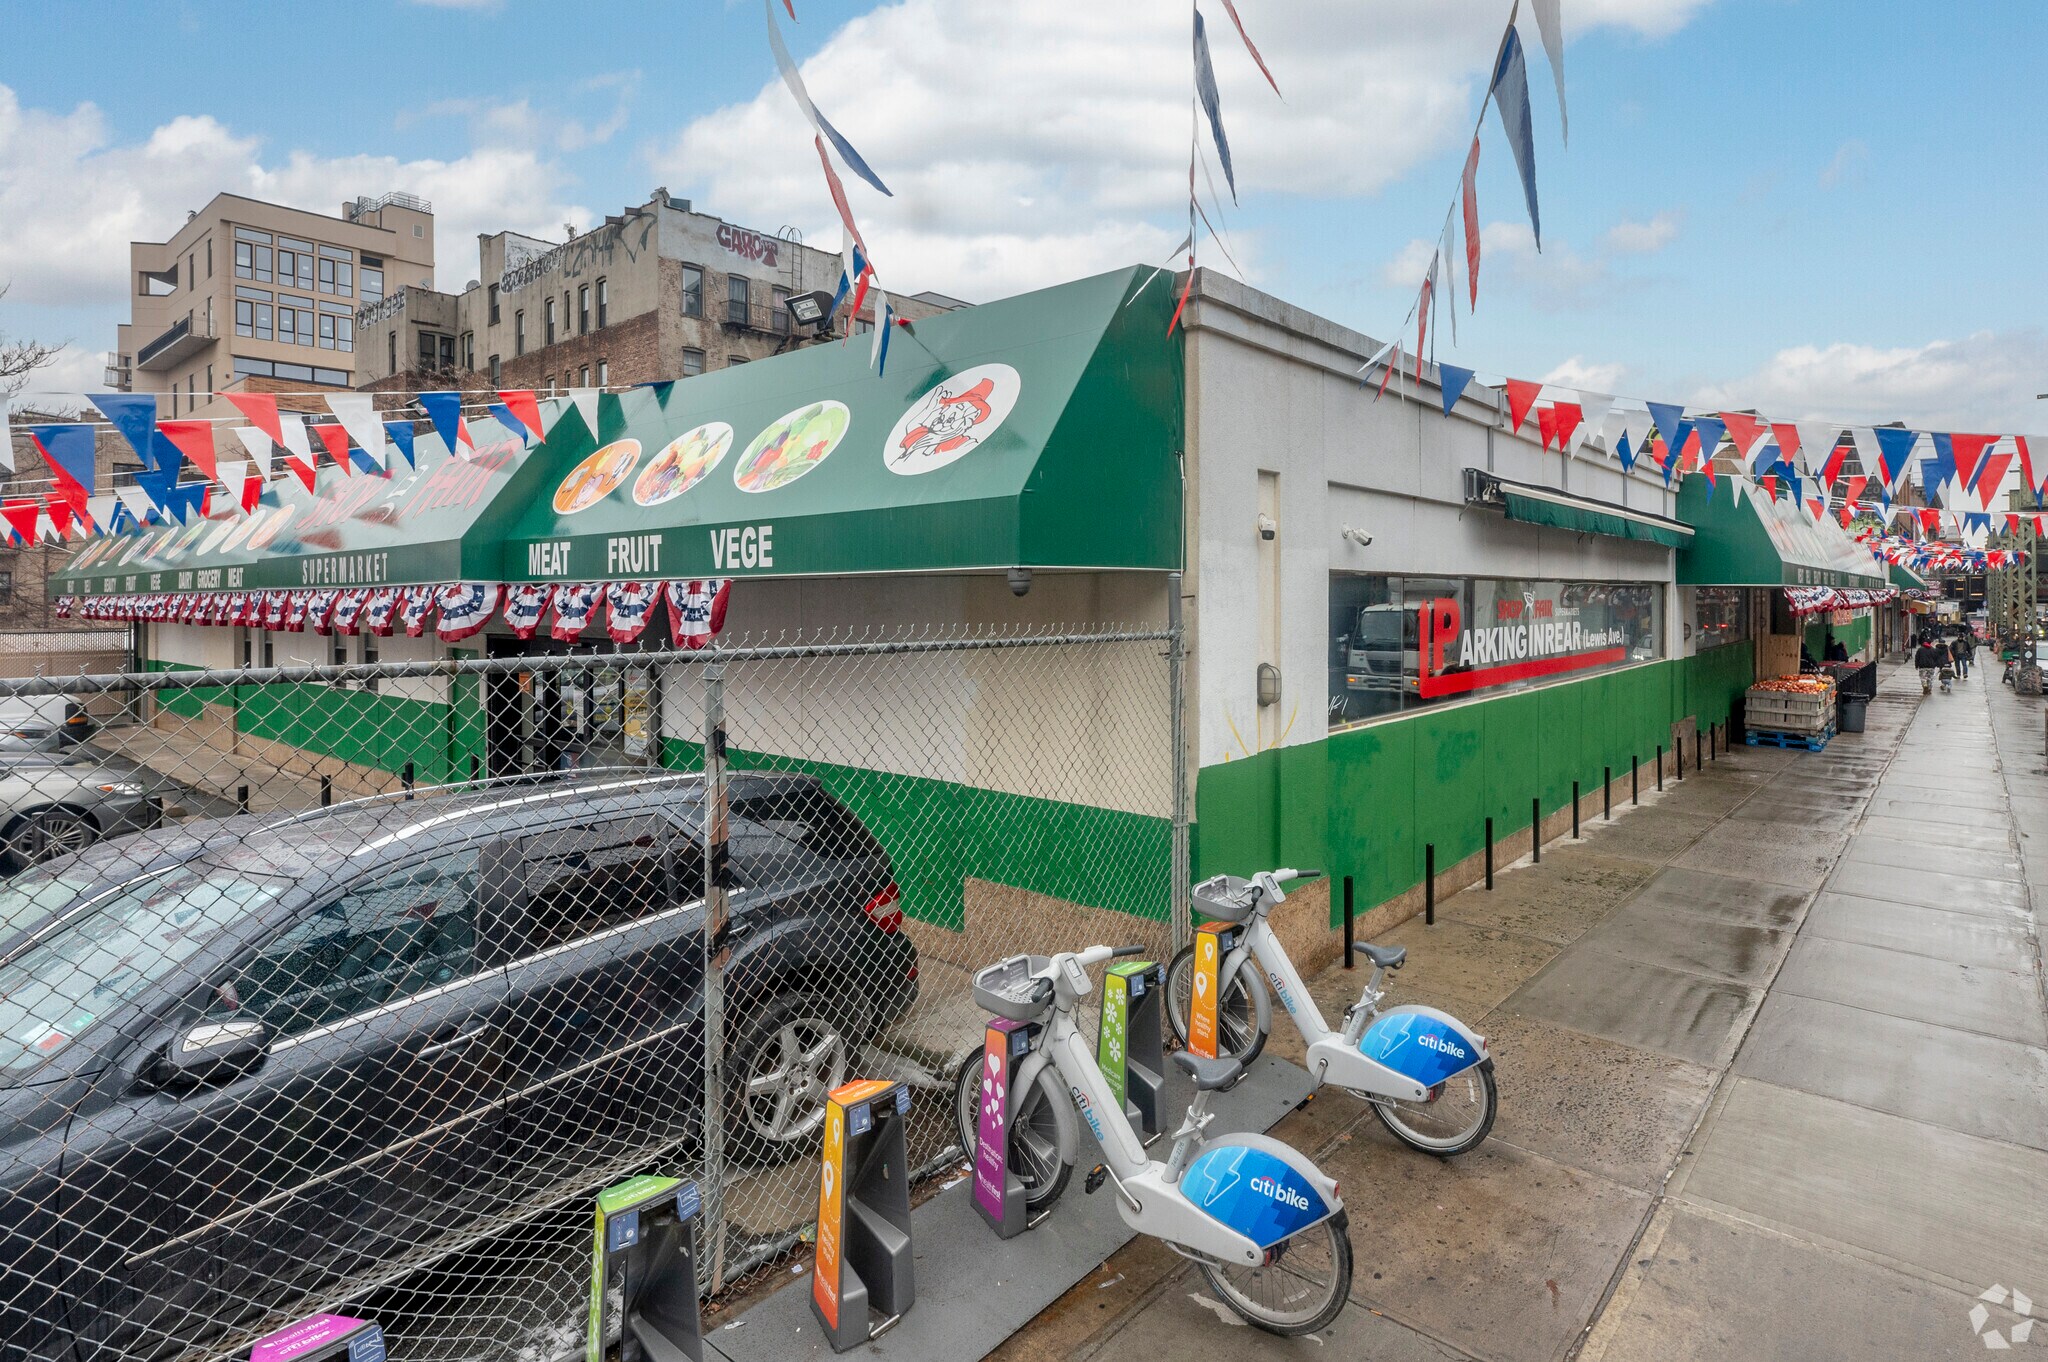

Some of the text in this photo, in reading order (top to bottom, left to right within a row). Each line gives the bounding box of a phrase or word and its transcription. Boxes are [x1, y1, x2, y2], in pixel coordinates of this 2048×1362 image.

[528, 525, 773, 576] MEAT FRUIT VEGE
[178, 571, 193, 590] DAIRY
[197, 568, 222, 589] GROCERY
[227, 567, 244, 588] MEAT
[302, 552, 388, 584] SUPERMARKET
[1497, 598, 1553, 620] SHOP FAIR
[1583, 628, 1607, 650] (Lewis
[1607, 626, 1625, 646] Ave.)
[1418, 1034, 1465, 1060] citi bike
[1072, 1086, 1105, 1142] citi bike
[1250, 1176, 1309, 1211] citi bike
[273, 1318, 331, 1346] healthfirst
